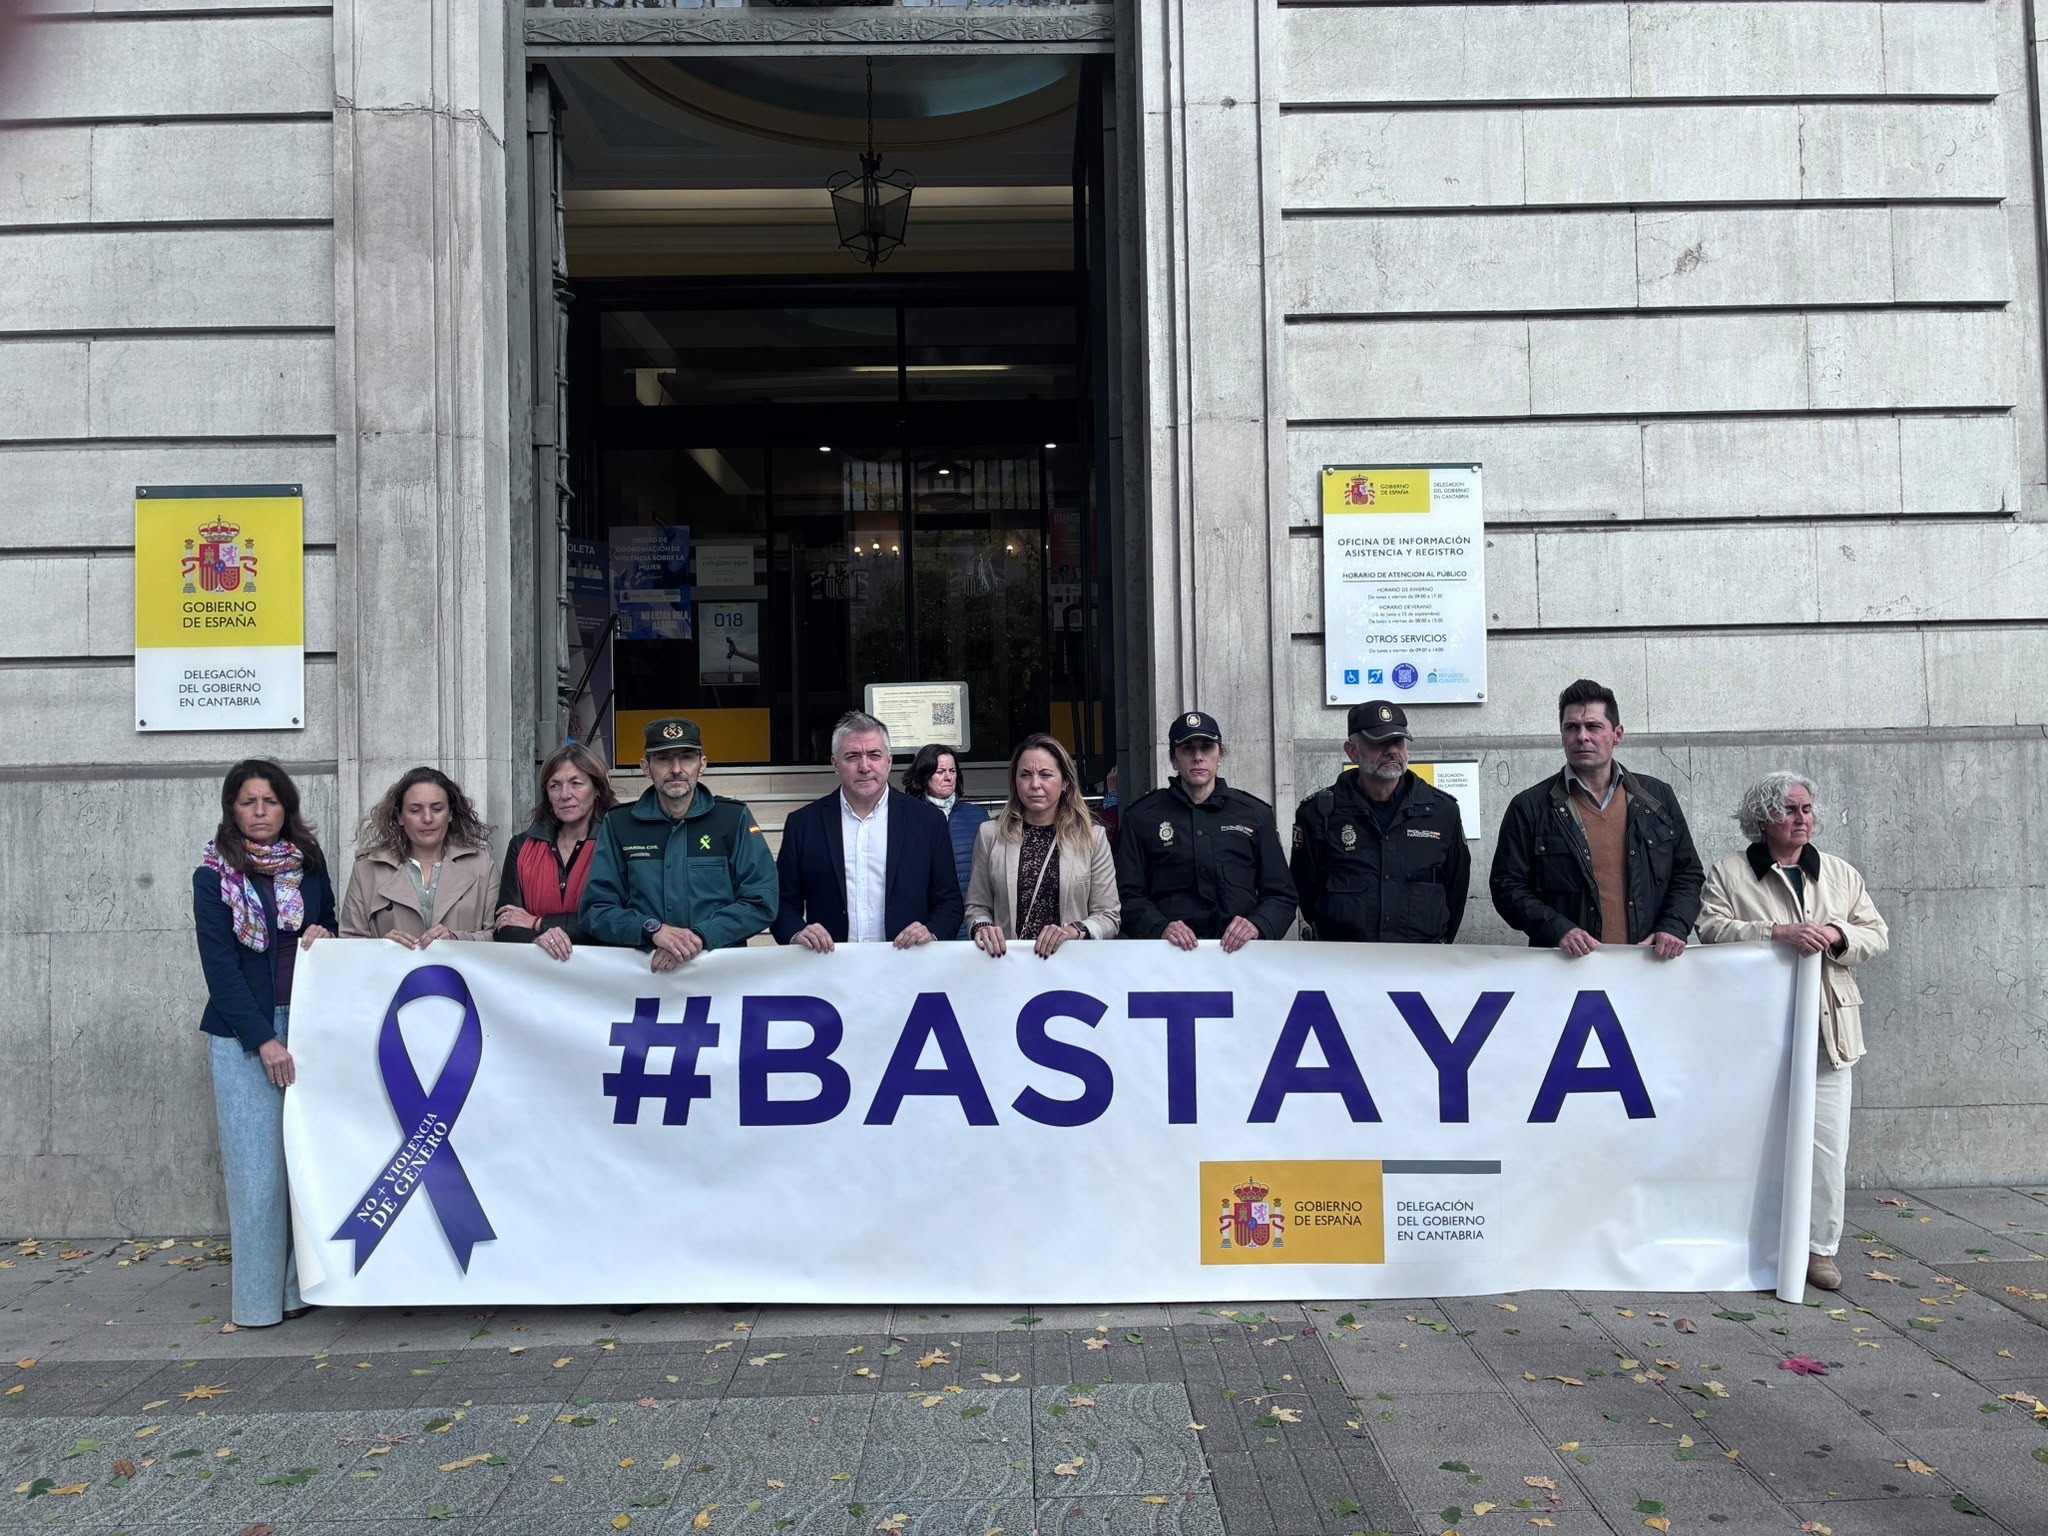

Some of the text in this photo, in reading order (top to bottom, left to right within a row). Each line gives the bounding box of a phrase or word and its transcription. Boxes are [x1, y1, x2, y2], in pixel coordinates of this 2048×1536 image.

[1389, 488, 1409, 496] ESPAÑA
[1338, 535, 1471, 546] OFICINA DE INFORMACIÓN
[1345, 549, 1403, 557] ASISTENCIA
[1416, 548, 1464, 556] REGISTRO
[1437, 569, 1467, 578] PÚBLICO
[183, 601, 257, 613] GOBIERNO
[183, 613, 257, 628] DE ESPAÑA
[714, 613, 743, 627] 018
[1366, 634, 1447, 644] OTROS SERVICIOS
[184, 667, 256, 680] DELEGACIÓN
[179, 682, 262, 693] DEL GOBIERNO
[179, 697, 262, 707] EN CANTABRIA
[602, 990, 1657, 1127] #BASTAYA
[356, 1197, 377, 1224] NO
[383, 1112, 438, 1183] VIOLENCIA
[370, 1121, 448, 1230] DE GENERO
[1294, 1201, 1363, 1213] GOBIERNO
[1397, 1199, 1474, 1212] DELEGACIÓN
[1294, 1212, 1362, 1226] DE ESPAÑA
[1397, 1215, 1485, 1227] DEL GOBIERNO
[1398, 1230, 1485, 1242] EN CANTABRIA
